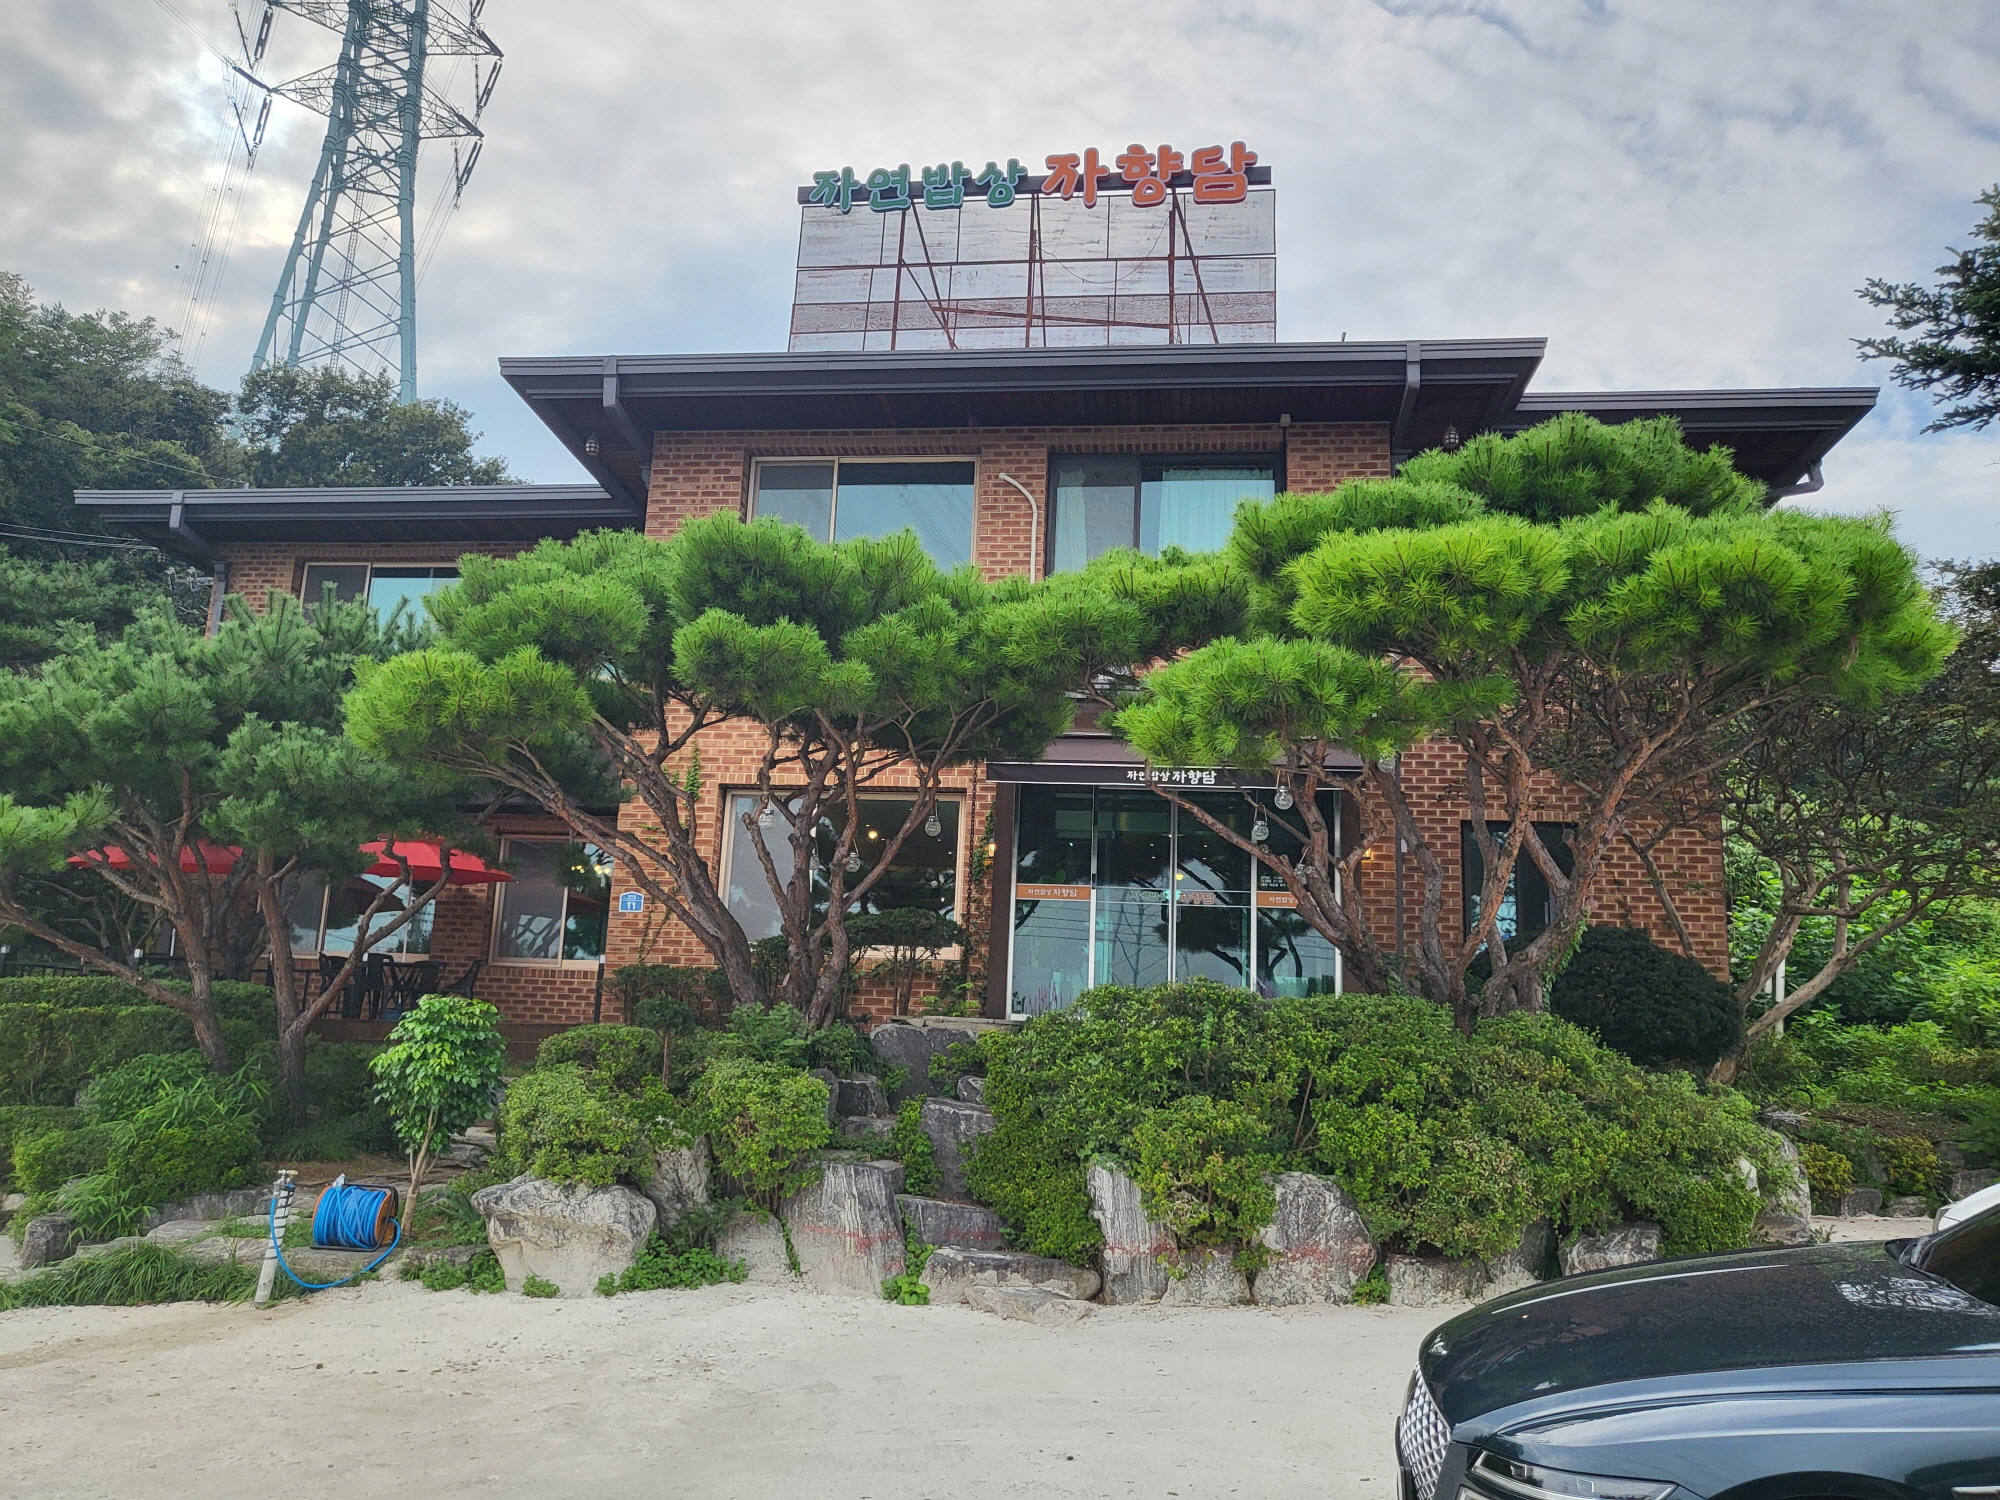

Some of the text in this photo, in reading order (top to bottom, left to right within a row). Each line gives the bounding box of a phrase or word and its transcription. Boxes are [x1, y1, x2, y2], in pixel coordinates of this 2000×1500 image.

[809, 141, 1258, 214] 자연밥상 자향담
[1172, 770, 1217, 784] 자향담
[1027, 888, 1078, 897] 자연밥상 자향담
[626, 901, 636, 909] 11
